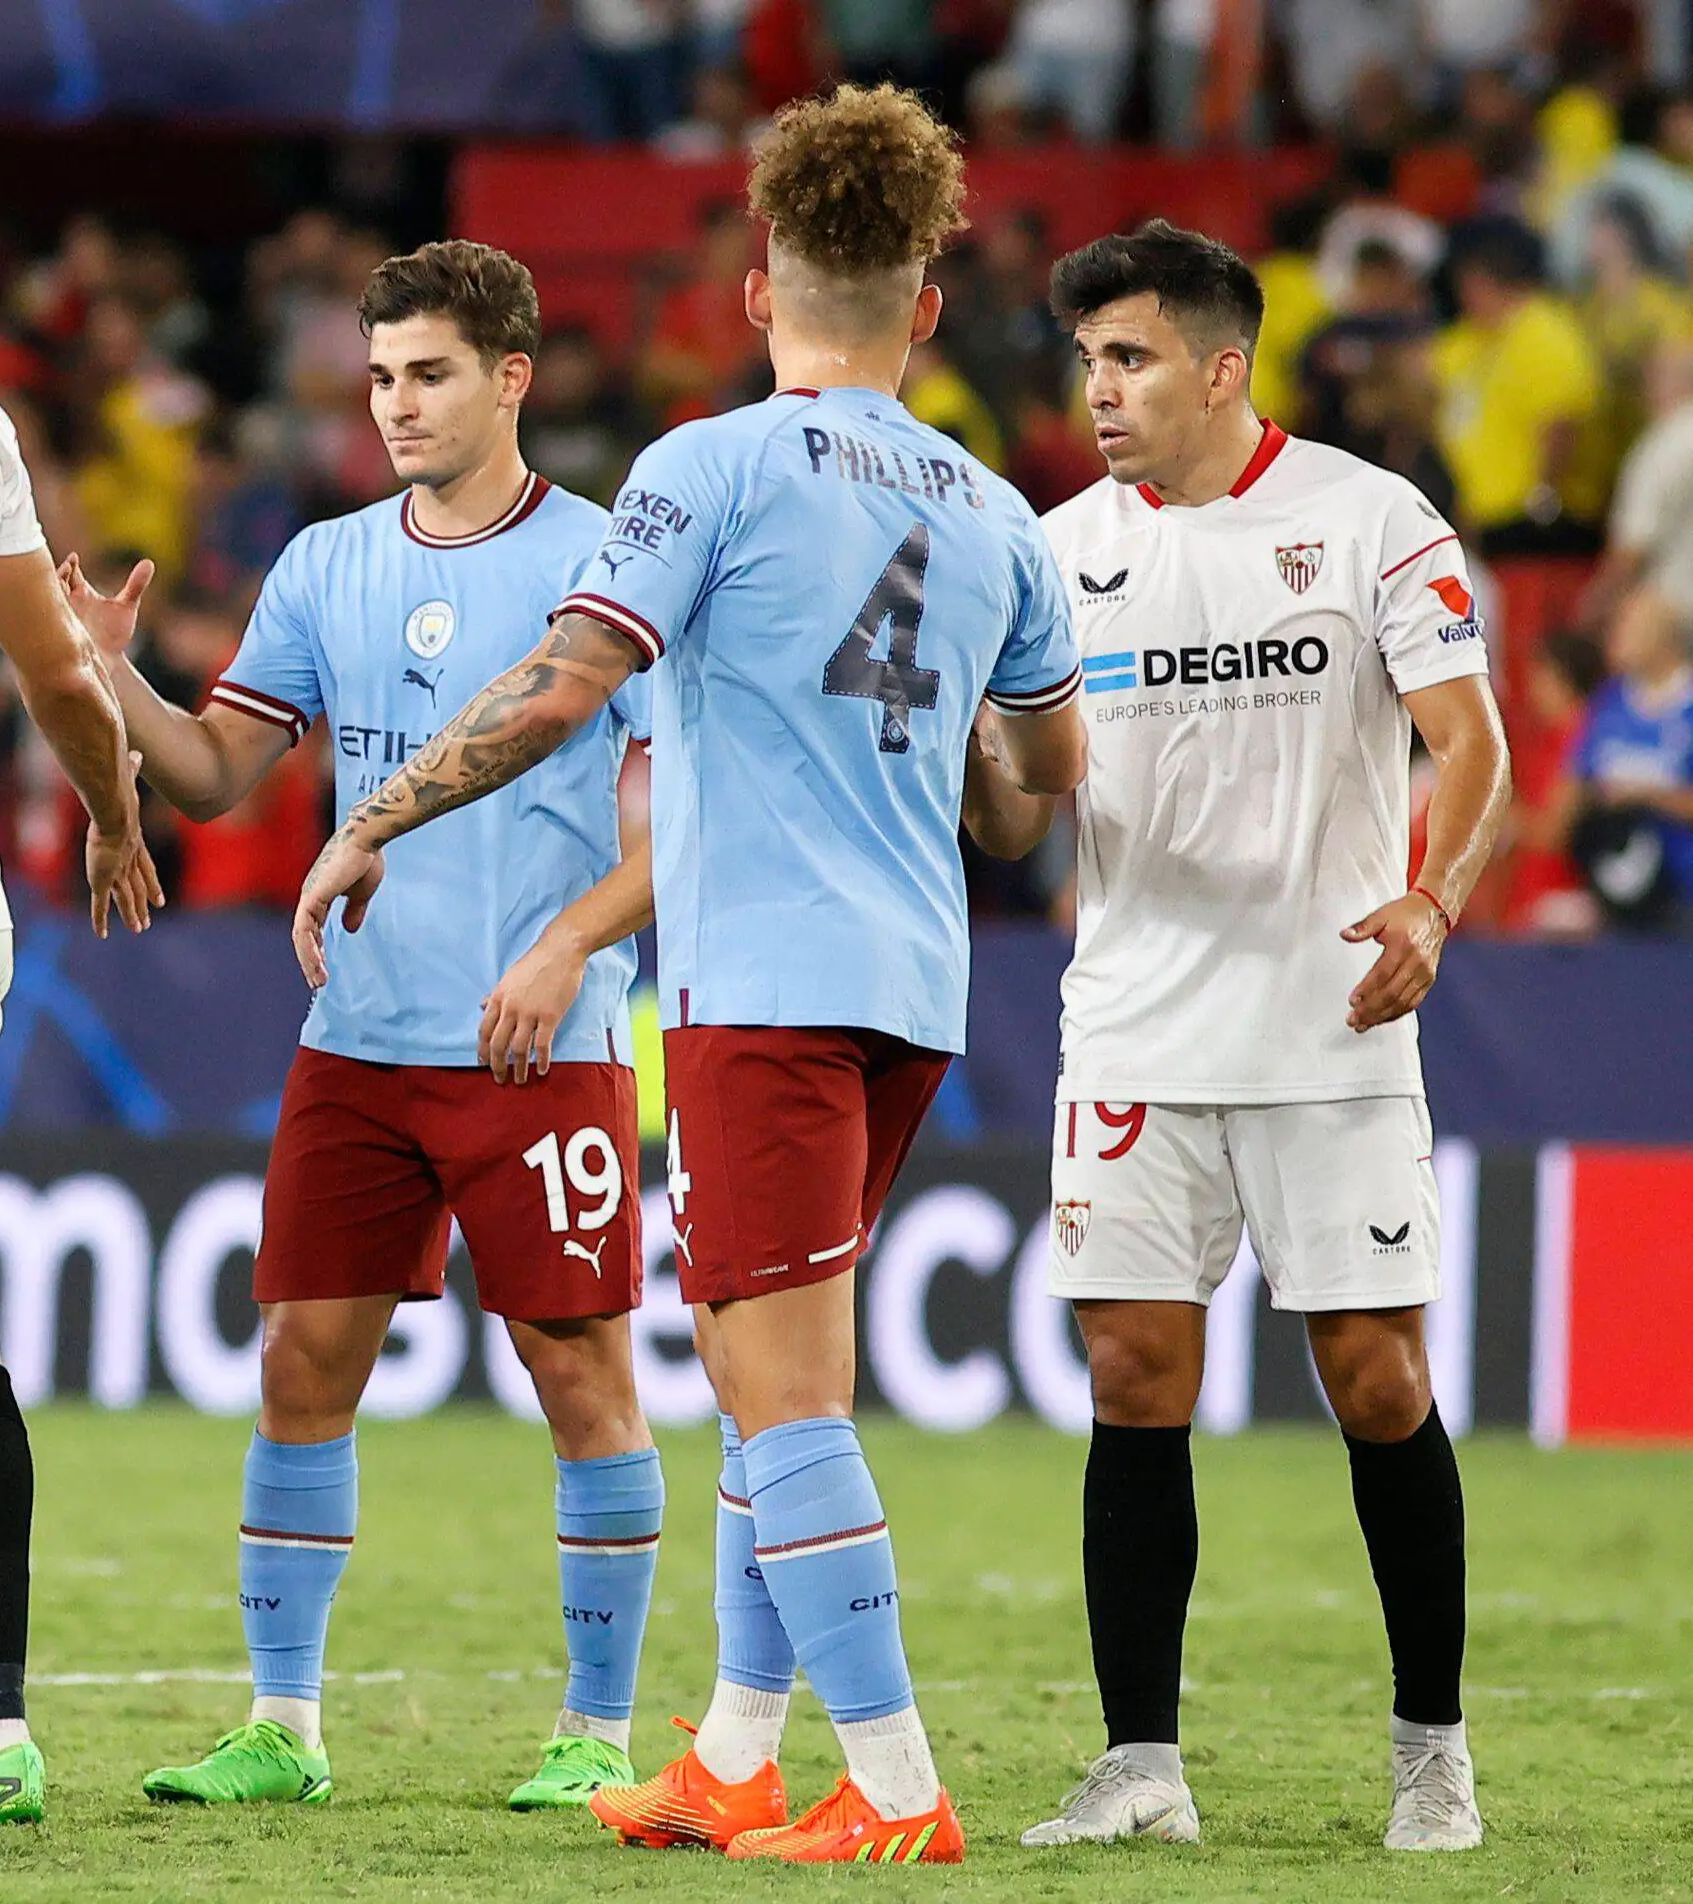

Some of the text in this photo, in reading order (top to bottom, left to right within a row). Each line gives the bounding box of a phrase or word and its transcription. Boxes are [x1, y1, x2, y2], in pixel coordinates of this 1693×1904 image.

[802, 427, 985, 510] PHILLIPS
[609, 515, 666, 550] TIRE
[618, 489, 692, 534] EXEN
[1079, 594, 1127, 607] CASTORE
[821, 521, 941, 754] 4
[1143, 636, 1329, 688] DEGIRO
[1096, 689, 1322, 724] EUROPE'S LEADING BROKER
[339, 725, 433, 764] ETIH
[1066, 1100, 1147, 1161] 19
[521, 1126, 623, 1233] 19
[666, 1108, 692, 1215] 4
